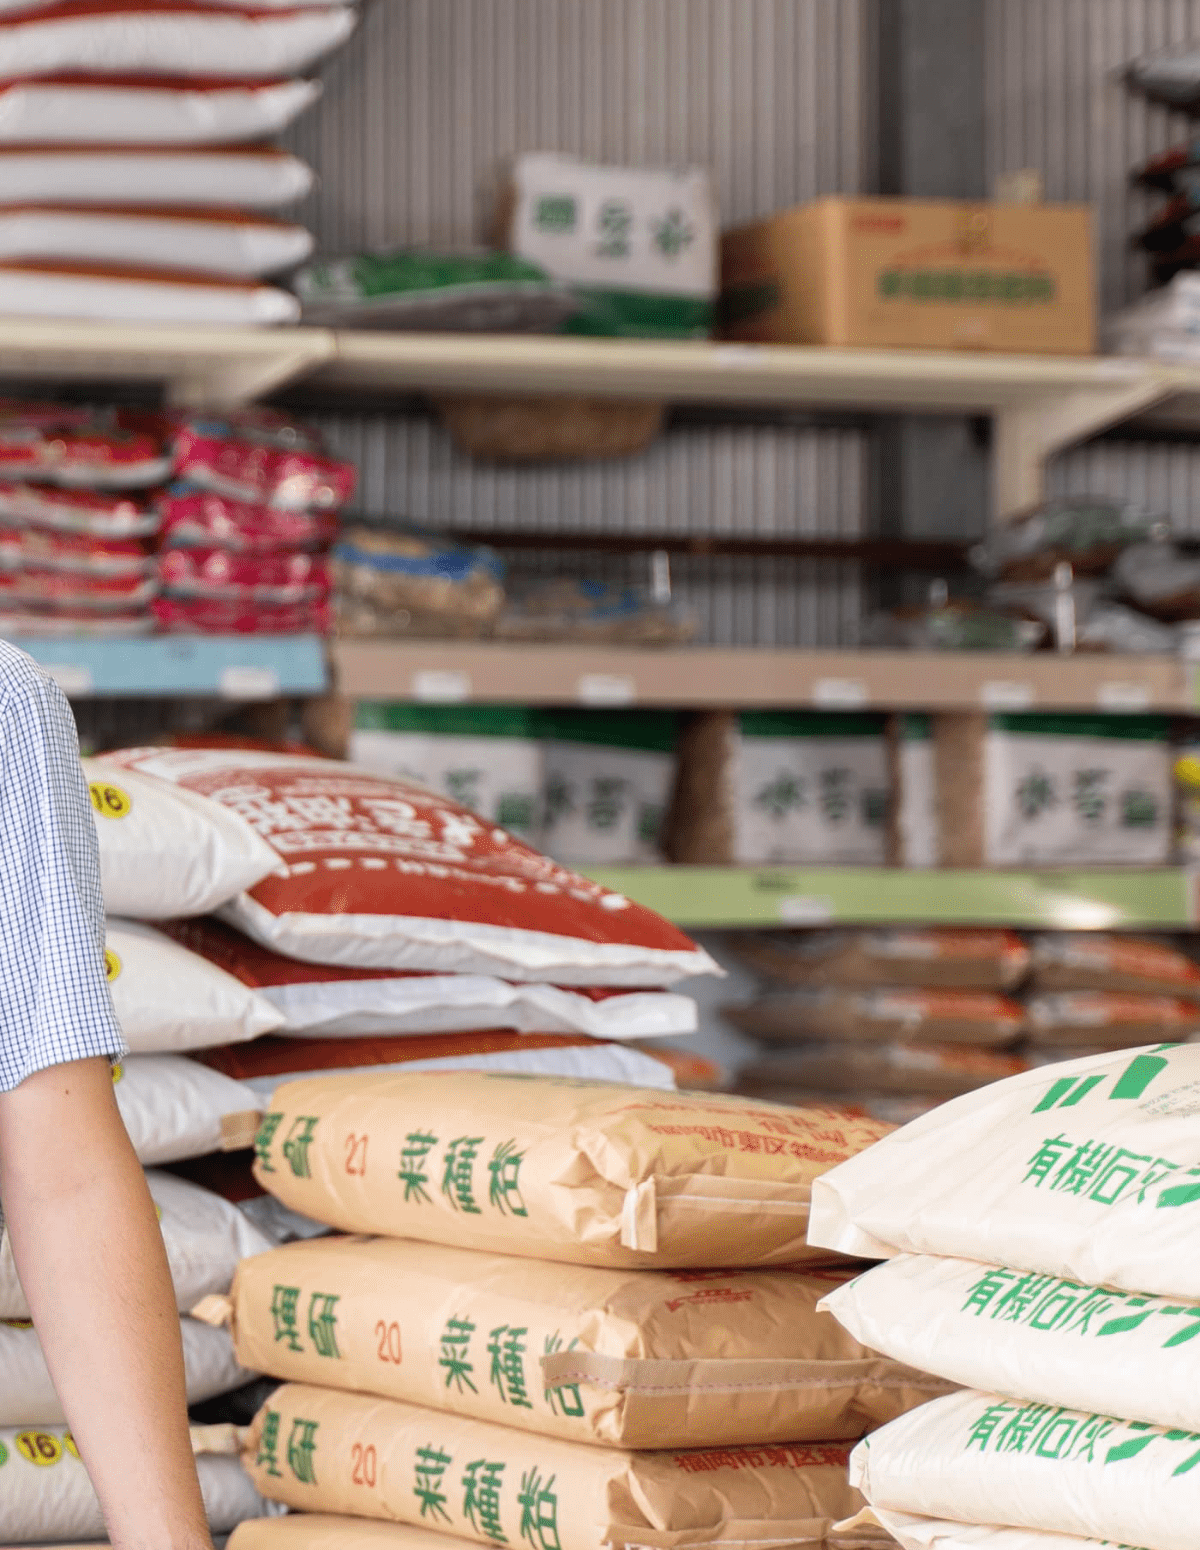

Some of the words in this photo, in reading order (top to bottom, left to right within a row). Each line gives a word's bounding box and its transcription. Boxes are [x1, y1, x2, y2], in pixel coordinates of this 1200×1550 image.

[90, 786, 123, 812] 16
[399, 1129, 530, 1217] 菜種粕
[375, 1320, 404, 1366] 20
[21, 1434, 57, 1459] 16
[351, 1443, 377, 1488] 20
[413, 1442, 563, 1550] 菜種粕
